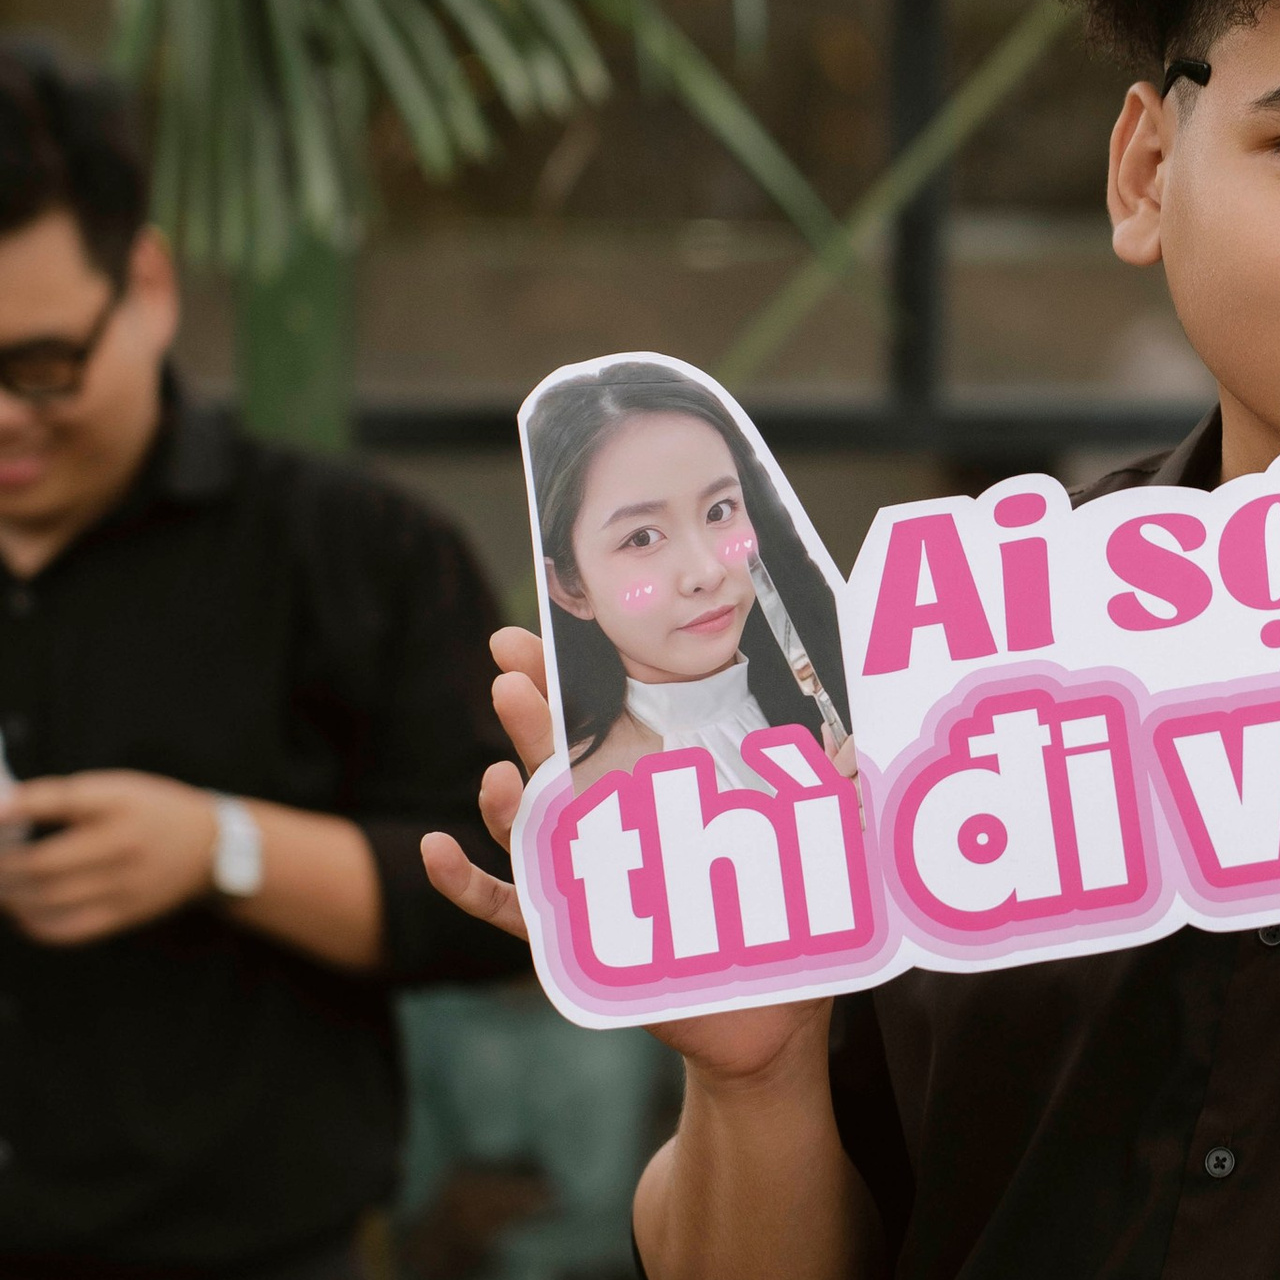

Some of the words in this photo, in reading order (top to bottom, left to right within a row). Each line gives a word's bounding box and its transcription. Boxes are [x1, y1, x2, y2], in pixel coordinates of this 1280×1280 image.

[863, 493, 1056, 676] Ai
[570, 742, 856, 968] thì
[912, 707, 1128, 913] đi
